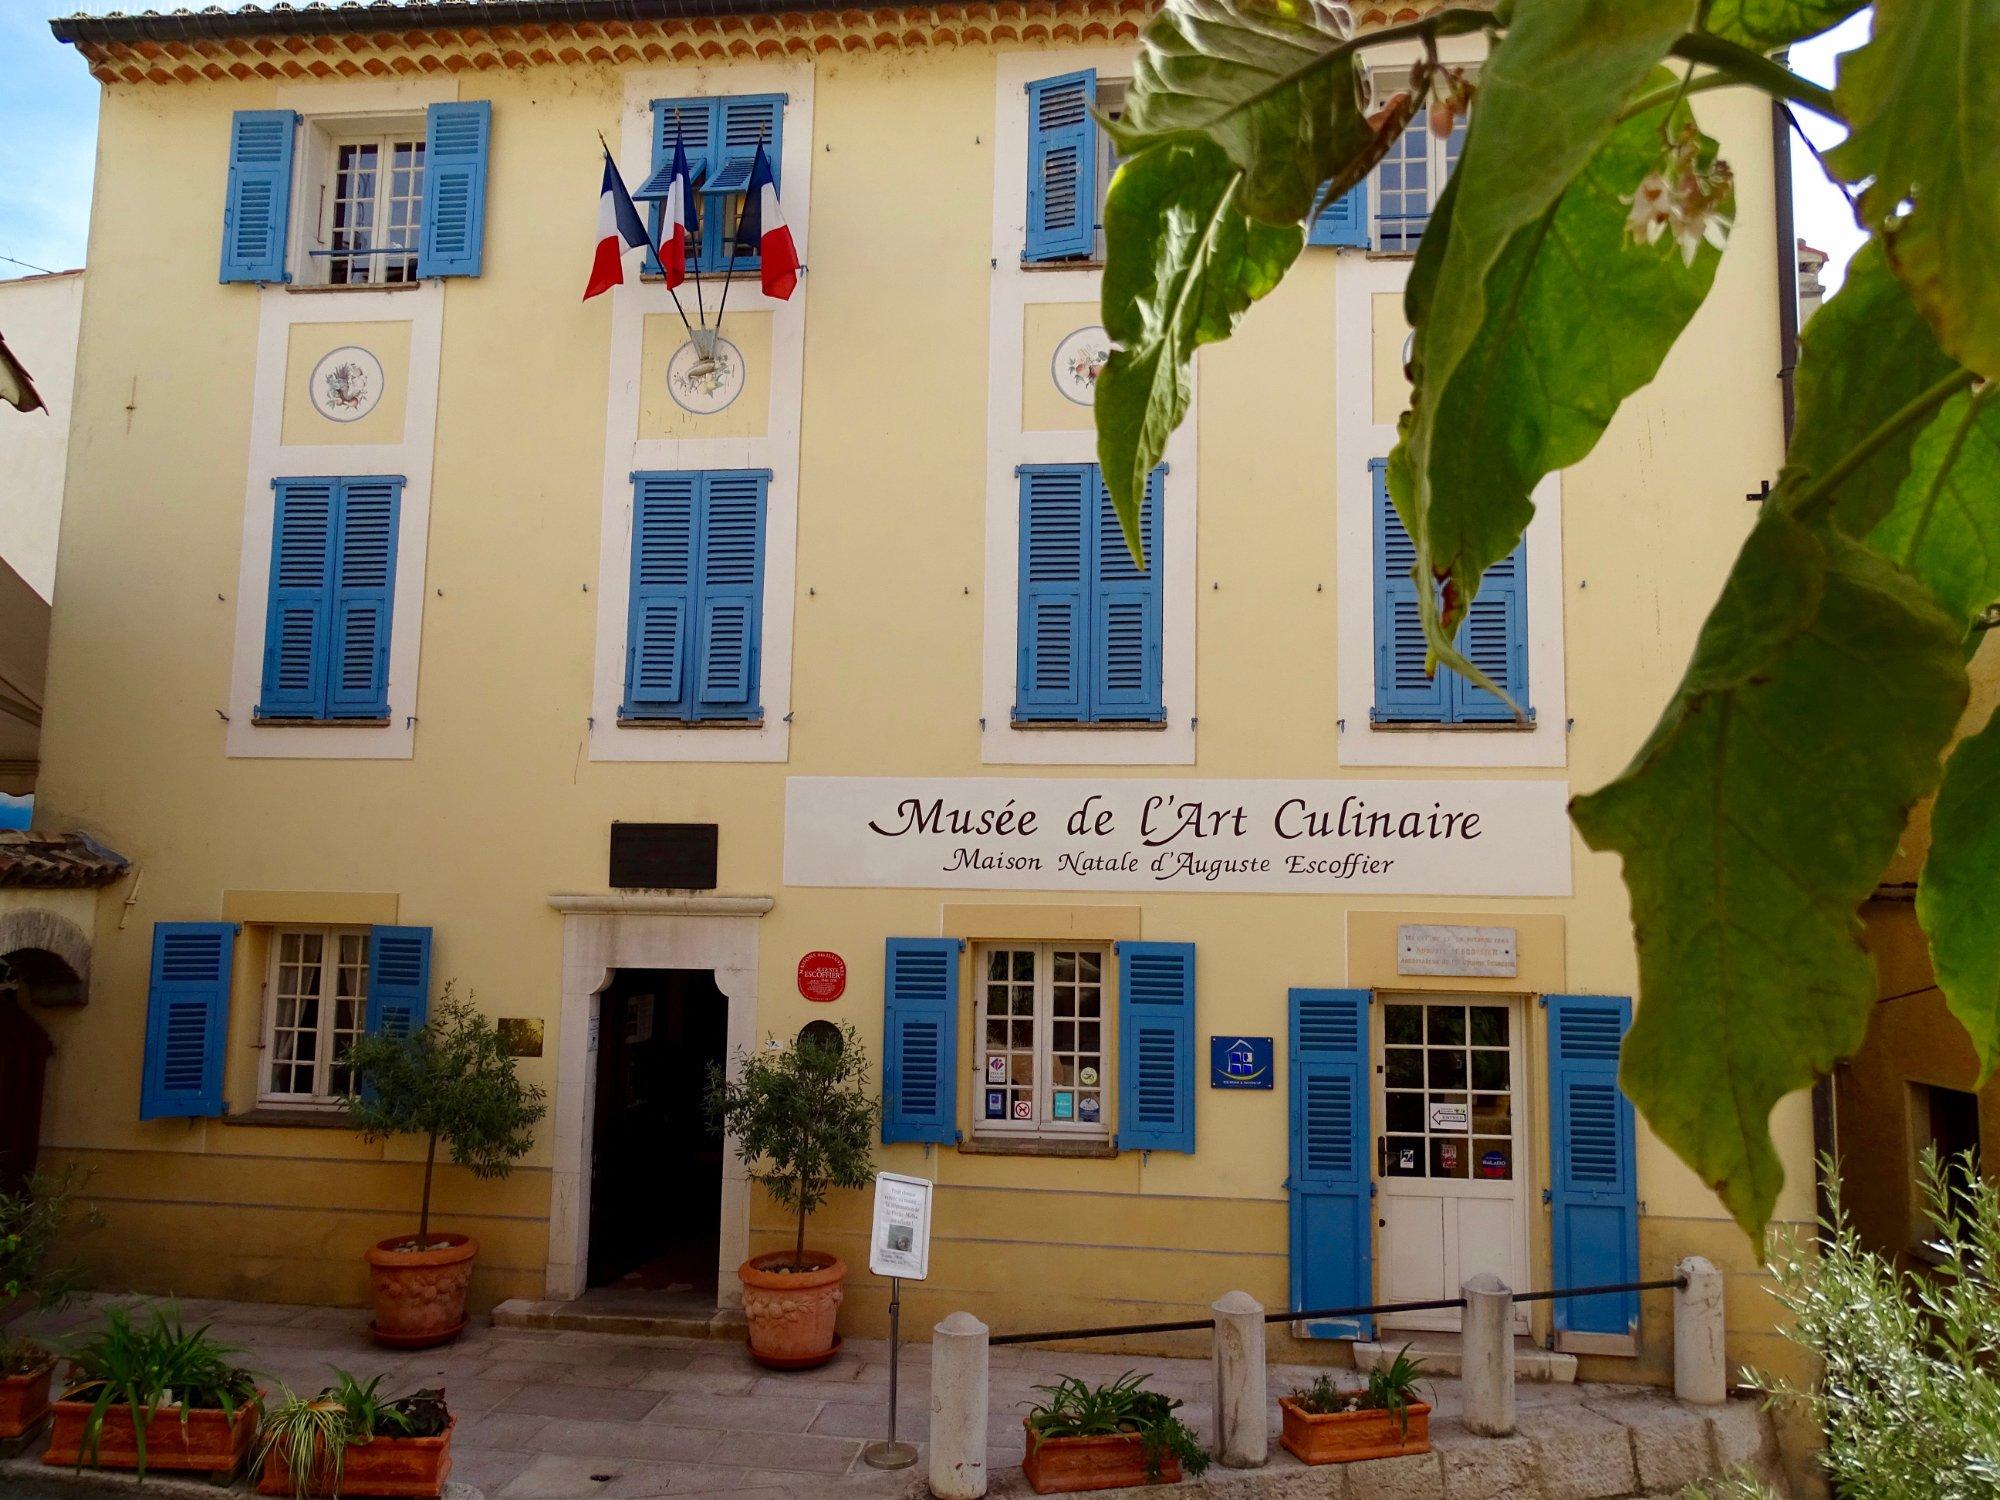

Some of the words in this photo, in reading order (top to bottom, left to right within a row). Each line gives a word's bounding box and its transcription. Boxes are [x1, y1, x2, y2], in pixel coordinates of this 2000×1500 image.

[869, 799, 1038, 836] Musée
[1067, 795, 1115, 836] de
[1141, 795, 1248, 846] l'Art
[1275, 796, 1482, 839] Culinaire
[943, 849, 1043, 872] Maison
[1058, 851, 1139, 875] Natale
[1151, 852, 1270, 880] d'Auguste
[1286, 853, 1394, 878] Escoffier
